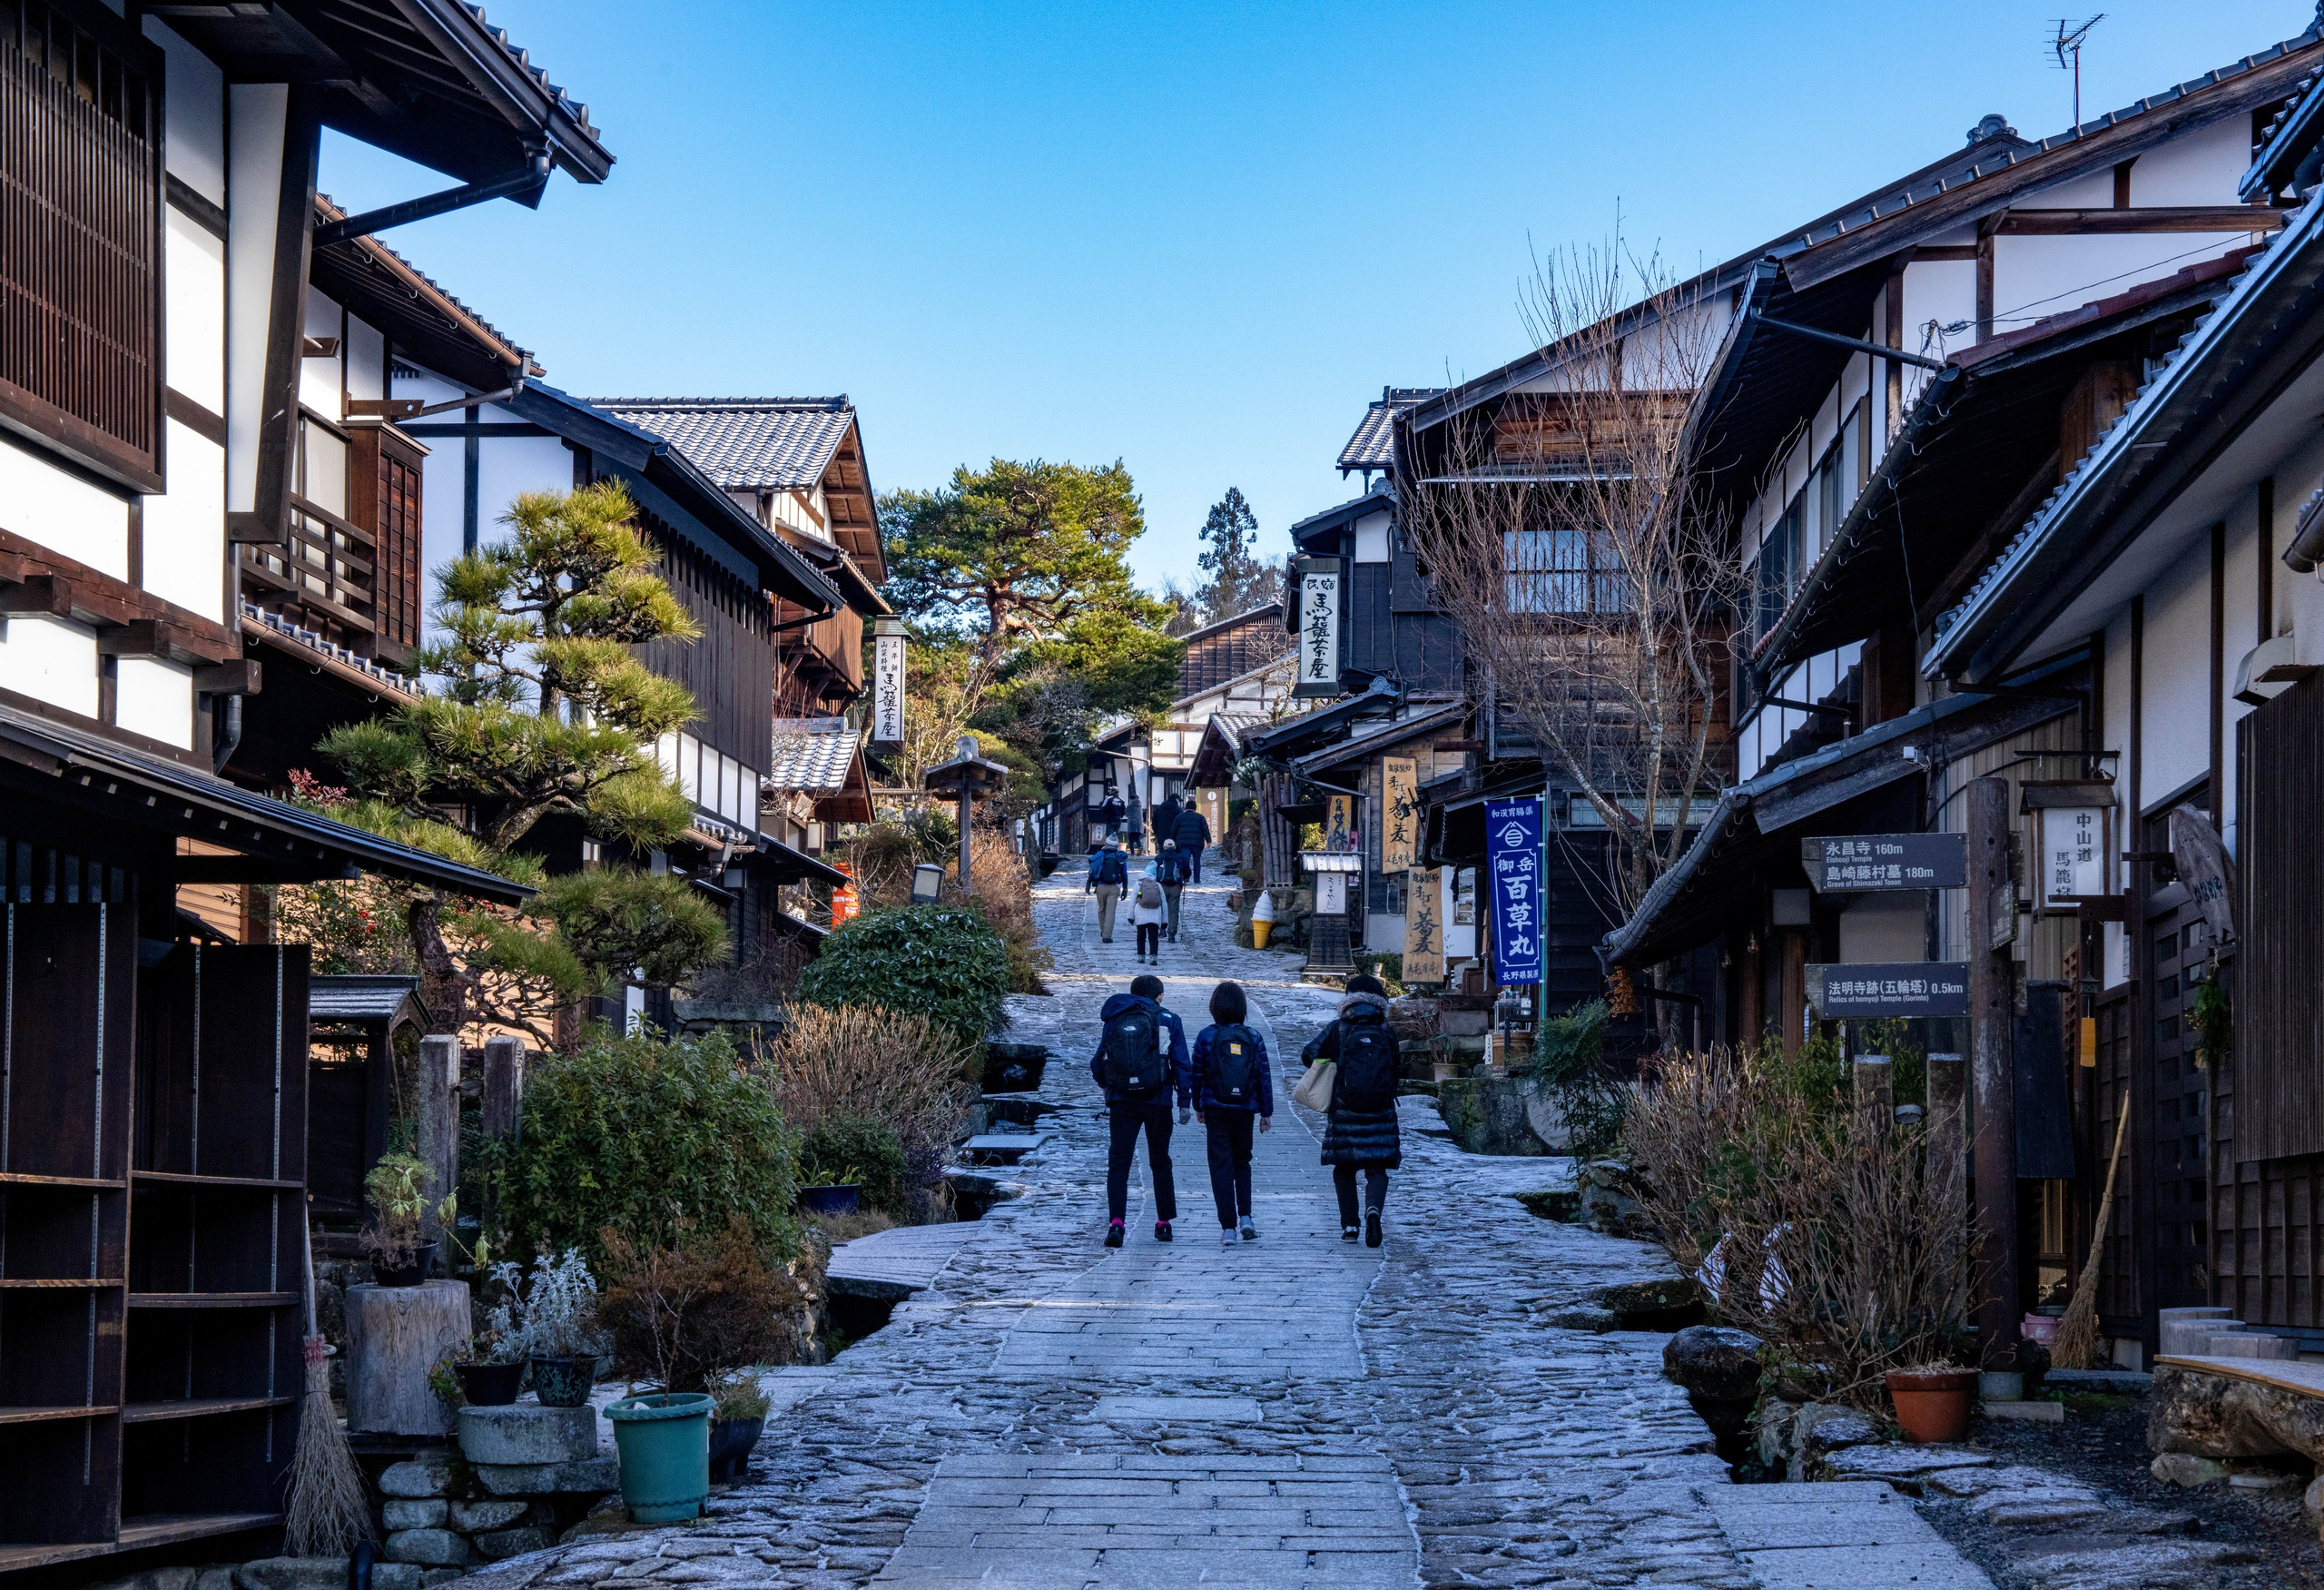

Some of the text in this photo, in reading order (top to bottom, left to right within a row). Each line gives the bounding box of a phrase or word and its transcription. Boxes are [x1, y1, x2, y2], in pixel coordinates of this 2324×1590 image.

[1307, 578, 1335, 591] 民宿
[1304, 593, 1333, 678] 馬籠茶屋
[877, 673, 898, 736] 馬籠茶屋
[1491, 805, 1534, 818] 和漢胃腸薬
[2076, 812, 2093, 863] 中山道
[1826, 841, 1904, 856] 永昌寺 160m
[1496, 856, 1535, 874] 御岳
[1827, 864, 1934, 881] 島崎藤村墓 180m
[1827, 880, 1845, 888] Grave
[1853, 879, 1884, 887] Shimazaki
[1501, 874, 1535, 956] 百草丸
[1828, 980, 1964, 996] 法明寺跡（五輪塔） 0.5km
[1903, 994, 1929, 1002] (Gorinto)
